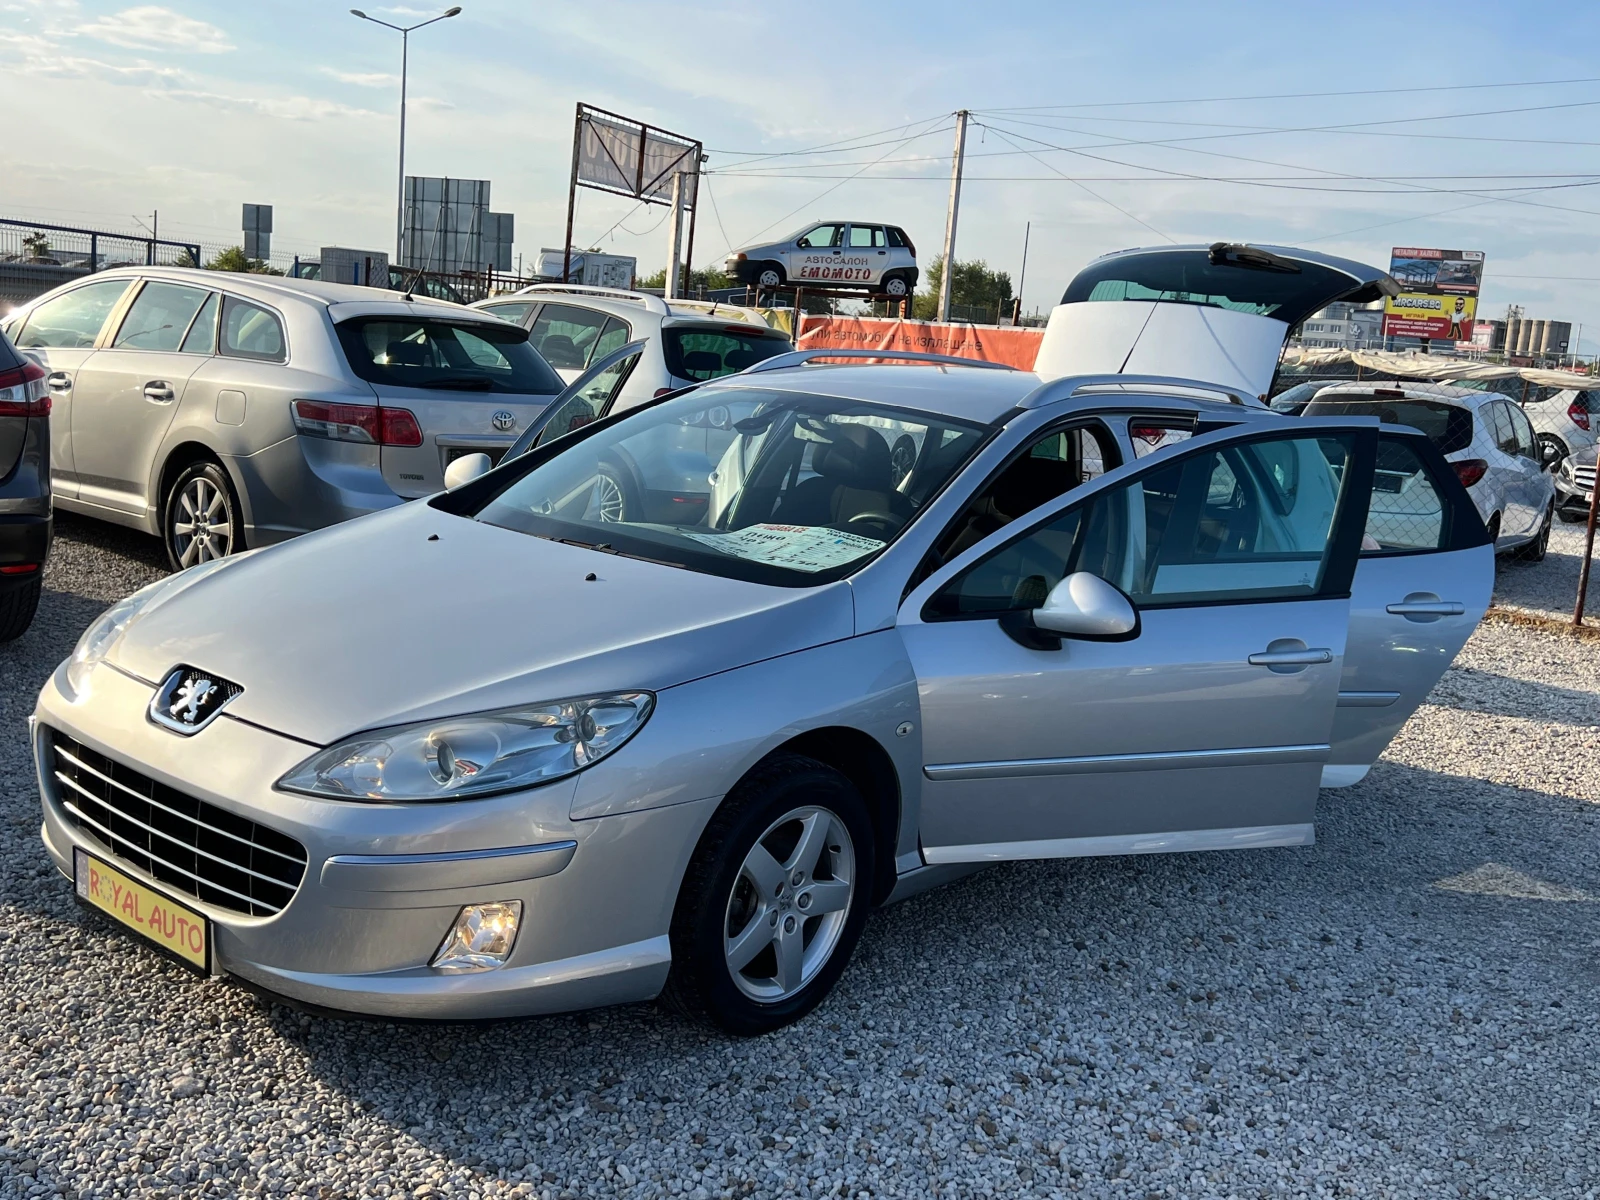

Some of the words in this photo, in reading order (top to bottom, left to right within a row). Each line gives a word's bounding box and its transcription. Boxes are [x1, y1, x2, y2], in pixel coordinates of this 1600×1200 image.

[805, 255, 868, 266] АВТОСАЛОН
[1393, 297, 1441, 310] MRCARS.BG
[148, 905, 204, 954] AUTO
